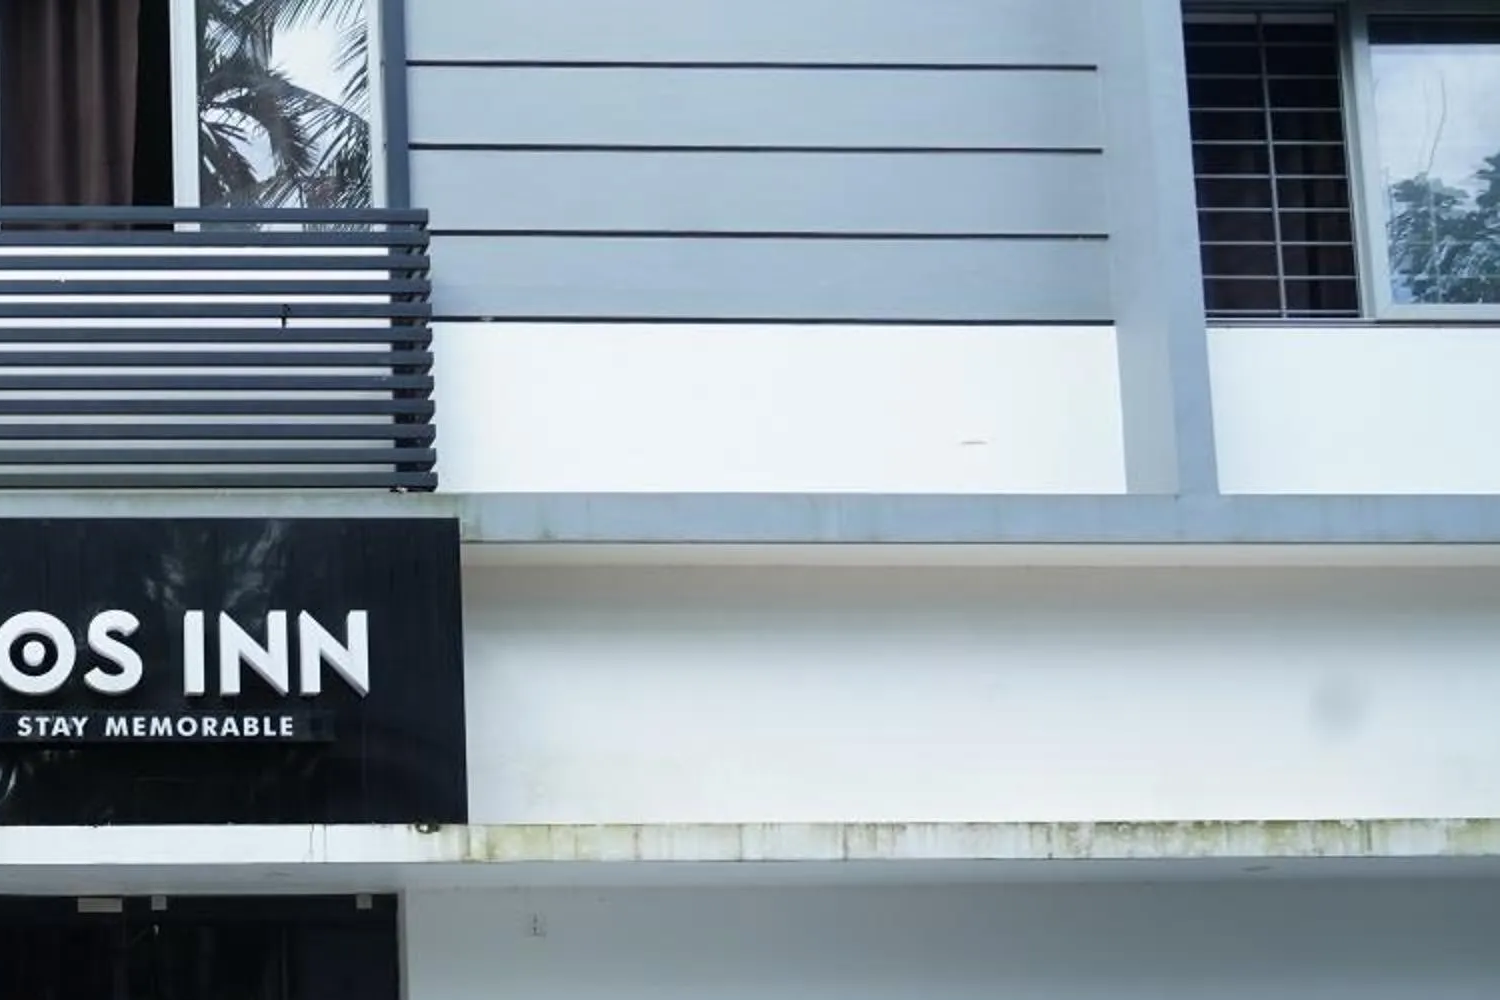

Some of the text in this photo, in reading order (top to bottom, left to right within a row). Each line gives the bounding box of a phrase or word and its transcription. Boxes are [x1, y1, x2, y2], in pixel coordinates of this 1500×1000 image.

[183, 609, 370, 696] INN
[17, 716, 88, 737] STAY
[105, 716, 294, 737] MEMORABLE
